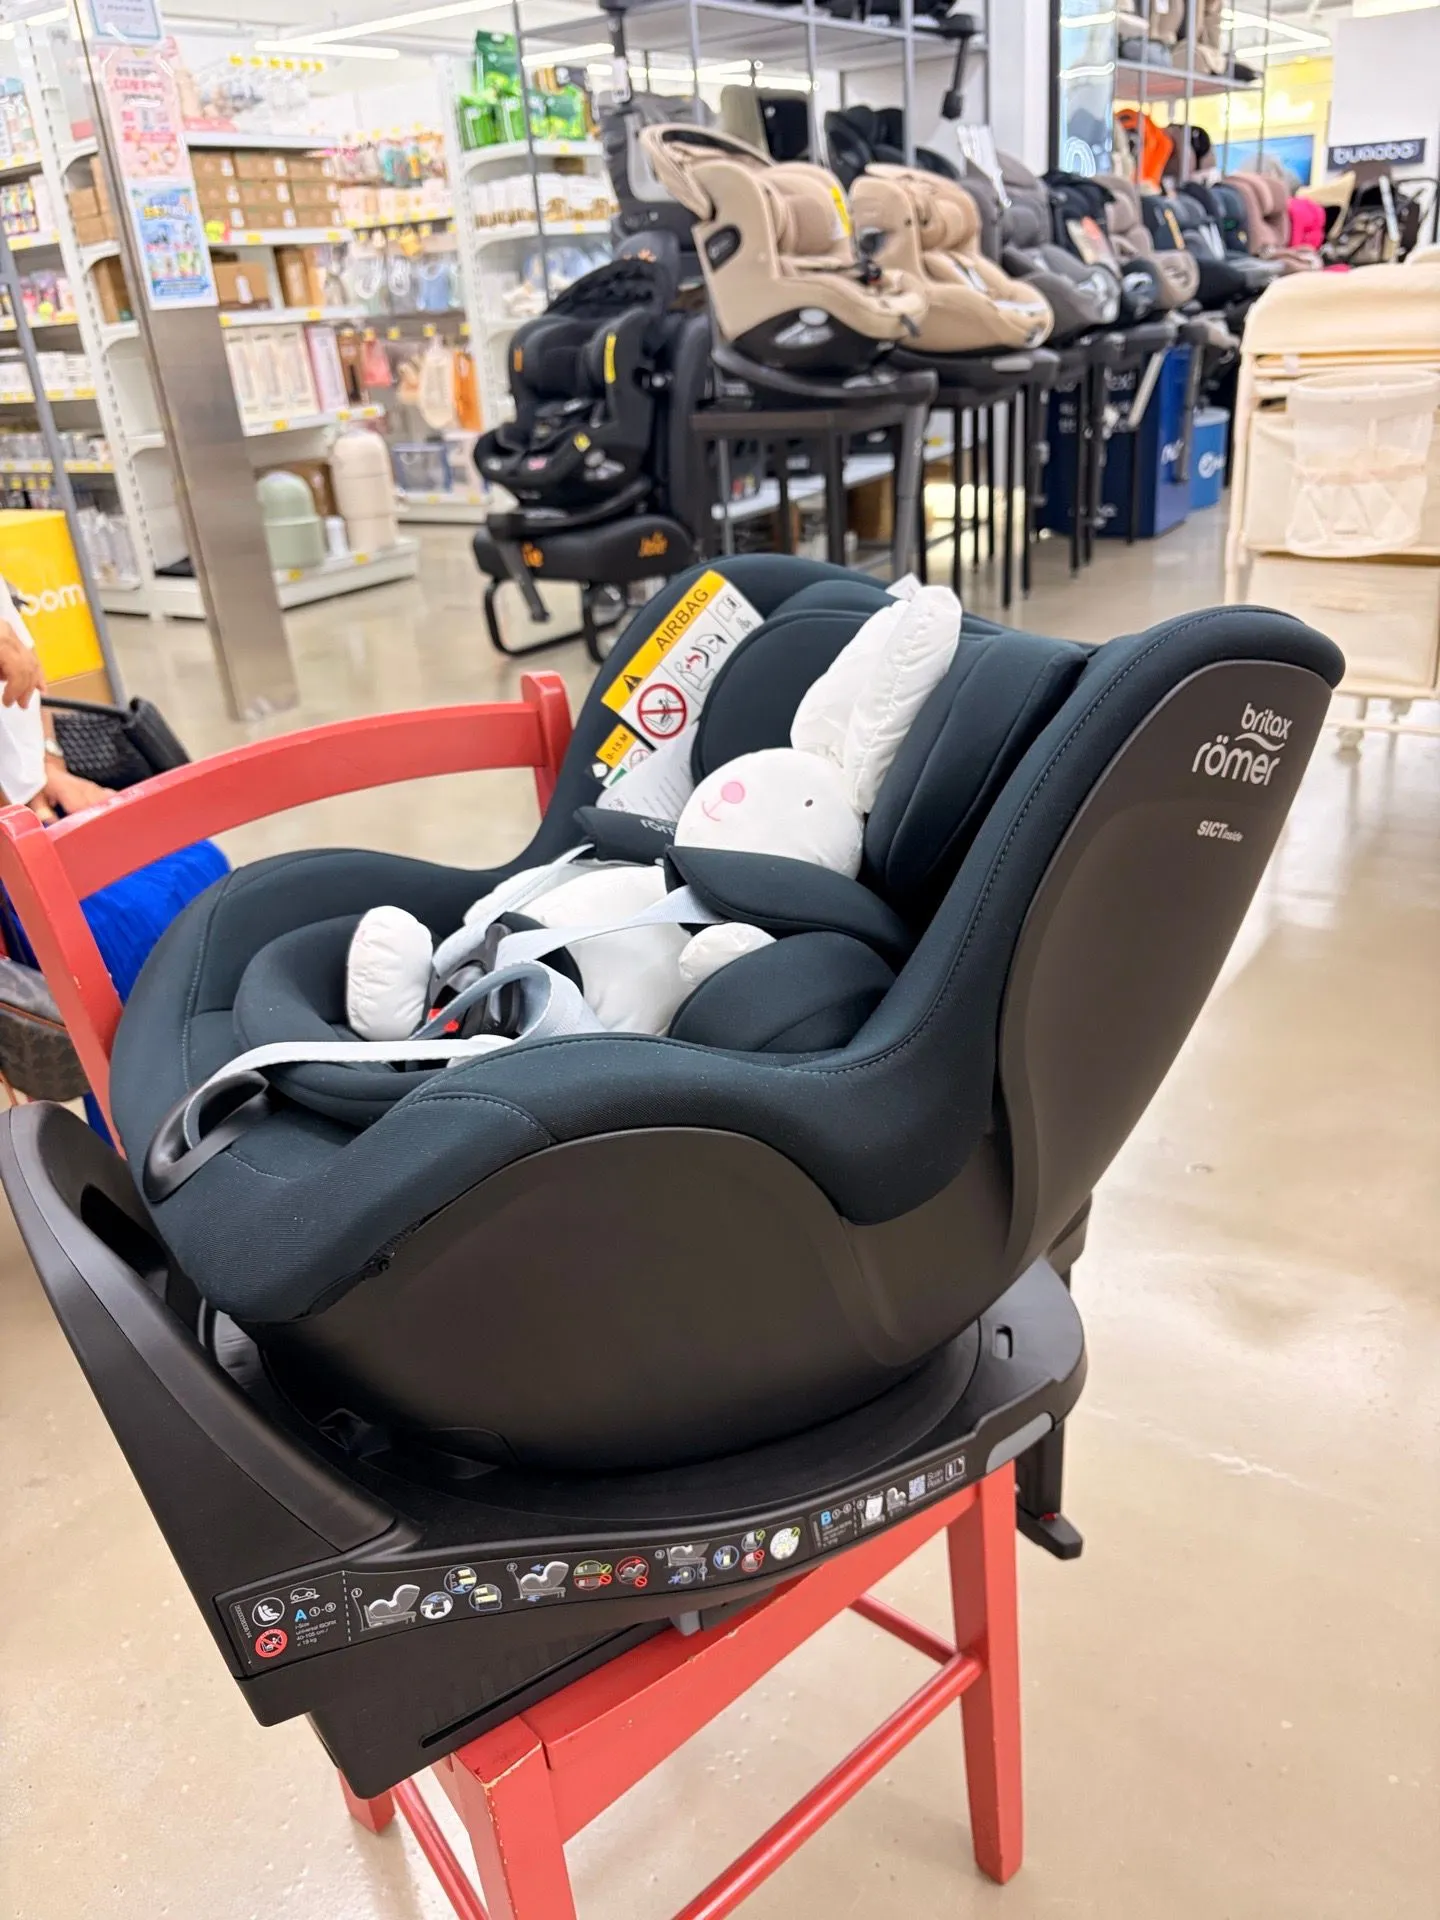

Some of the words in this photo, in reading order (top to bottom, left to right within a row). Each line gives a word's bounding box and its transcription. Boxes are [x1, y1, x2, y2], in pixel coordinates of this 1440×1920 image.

[655, 588, 709, 651] AIRBAG
[1241, 702, 1293, 740] britax
[1191, 734, 1281, 786] römer
[1197, 820, 1229, 839] SICT
[820, 1510, 832, 1526] B
[294, 1609, 307, 1622] A
